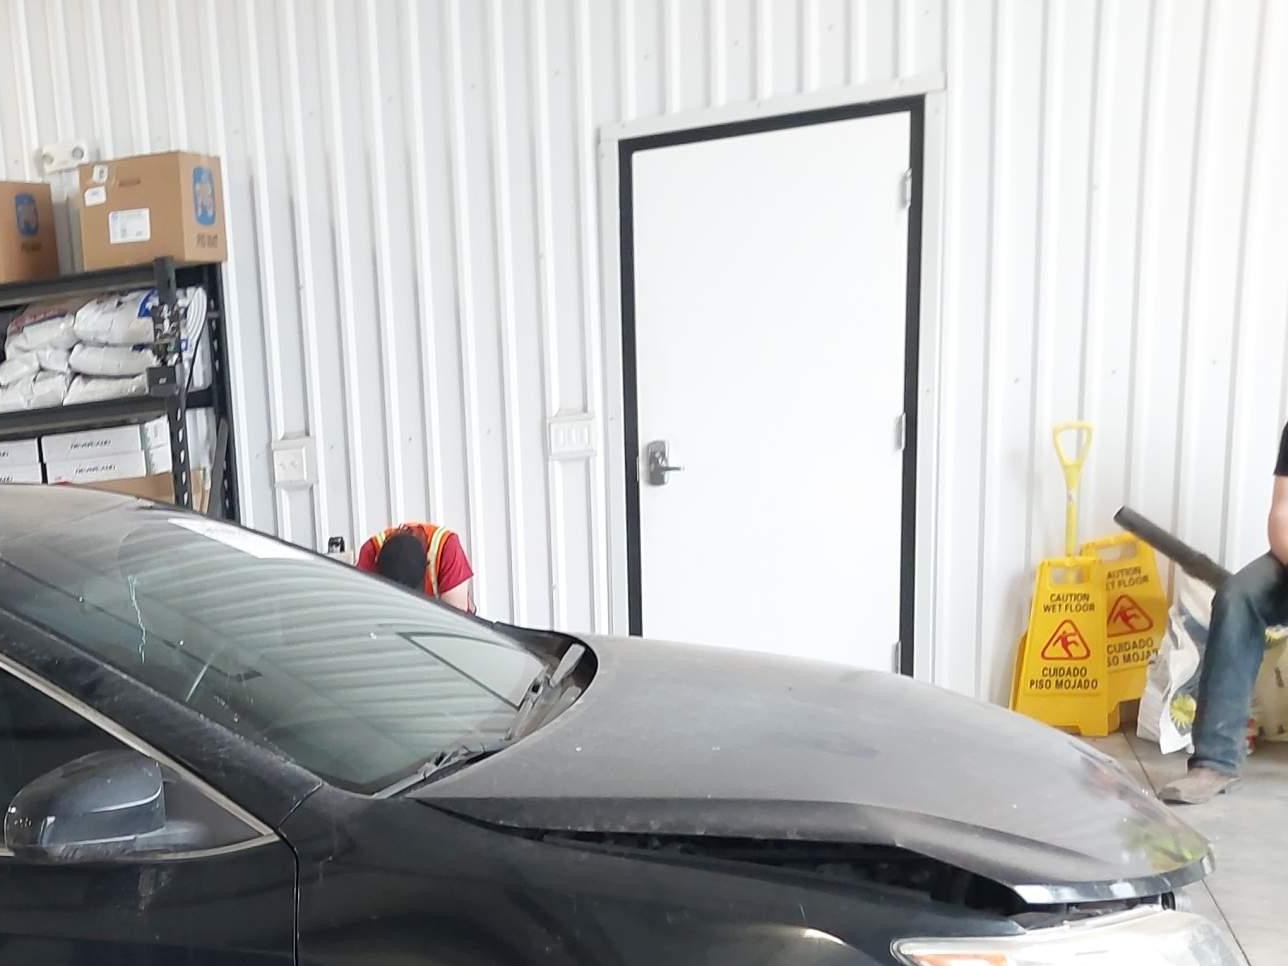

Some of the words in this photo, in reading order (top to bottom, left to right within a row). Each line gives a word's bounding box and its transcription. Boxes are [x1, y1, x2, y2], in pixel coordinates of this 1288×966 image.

[1107, 566, 1142, 580] AUTION
[1117, 575, 1149, 589] FLOOR
[1049, 592, 1090, 603] CAUTION
[1043, 604, 1063, 613] WET
[1065, 602, 1096, 613] FLOOR
[1106, 637, 1154, 655] CUIDADO
[1041, 666, 1088, 677] CUIDADO
[1029, 679, 1052, 689] PISO
[1054, 678, 1098, 689] MOJADO
